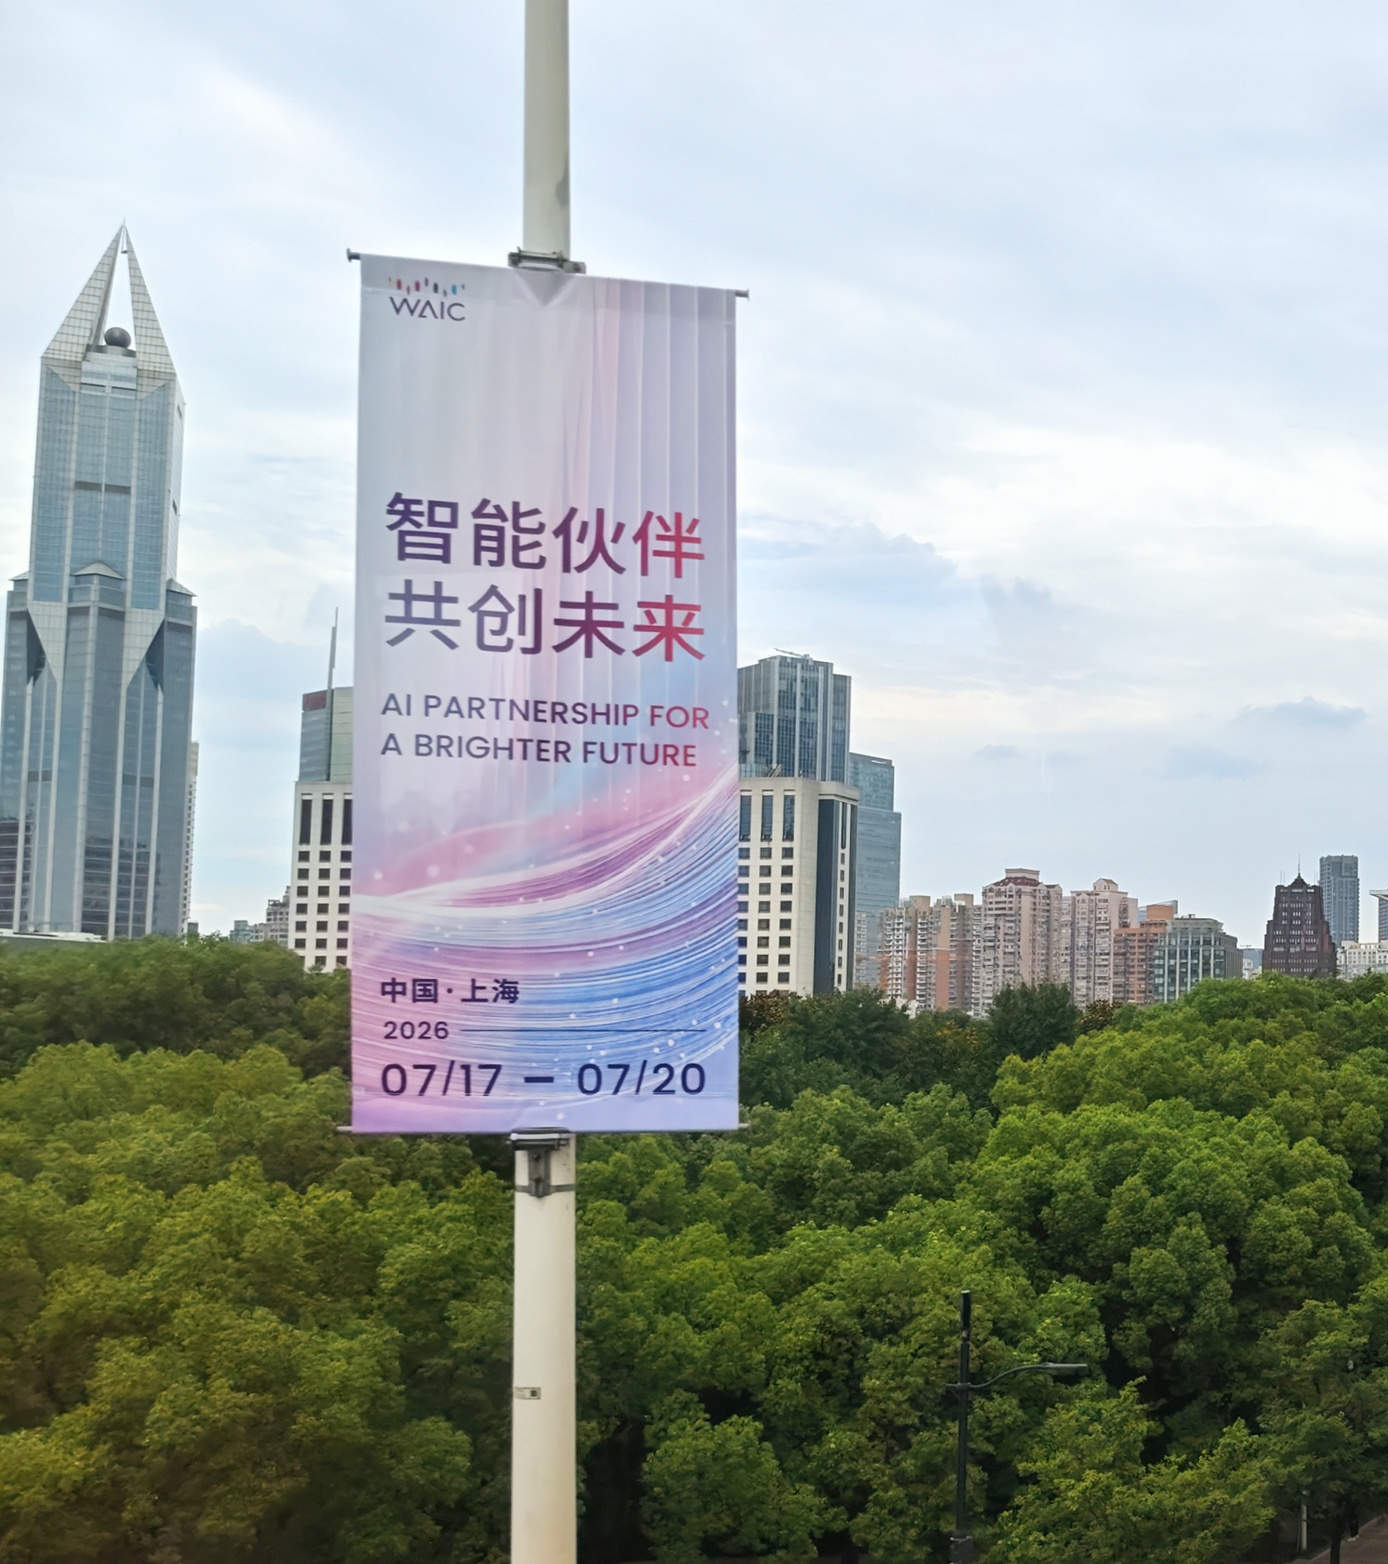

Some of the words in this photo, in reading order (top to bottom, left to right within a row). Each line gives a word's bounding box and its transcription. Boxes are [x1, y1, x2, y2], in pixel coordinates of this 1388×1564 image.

[389, 296, 466, 322] WAIC
[385, 491, 705, 579] 智能伙伴
[384, 578, 706, 662] 共创未来
[380, 693, 412, 717] AI
[423, 694, 640, 727] PARTNERSHIP
[649, 705, 710, 730] FOR
[380, 733, 403, 756] A
[414, 734, 571, 763] BRIGHTER
[583, 744, 697, 767] FUTURE
[380, 978, 520, 1004] 中国·上海
[383, 1020, 450, 1040] 2026
[380, 1060, 503, 1097] 07/17
[577, 1059, 706, 1097] 07/20
